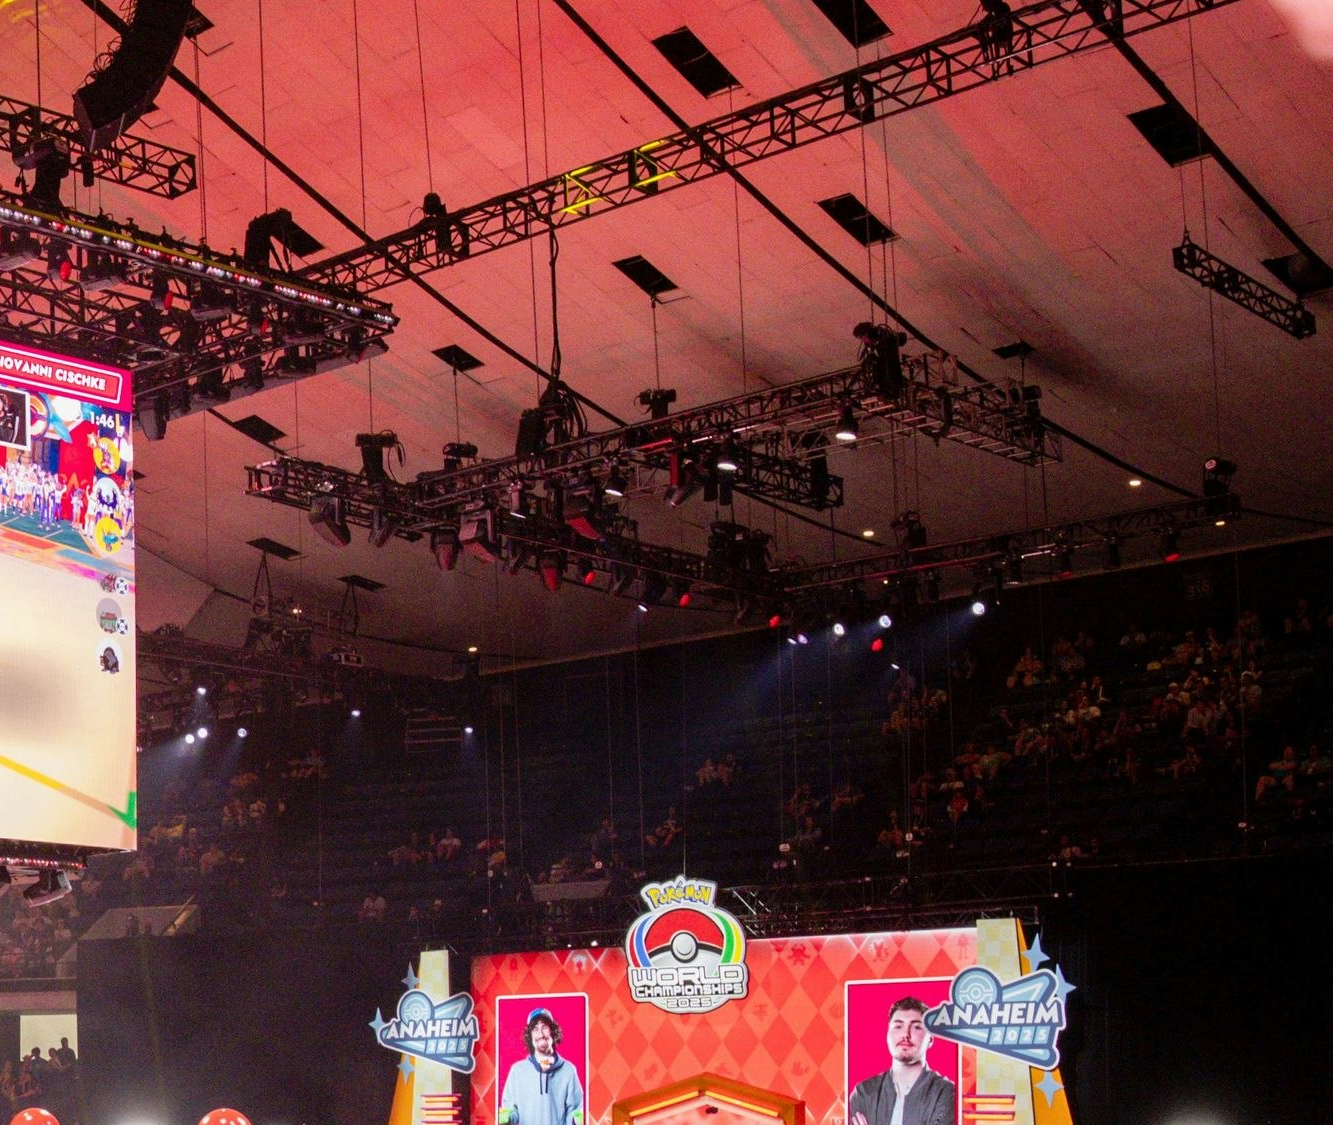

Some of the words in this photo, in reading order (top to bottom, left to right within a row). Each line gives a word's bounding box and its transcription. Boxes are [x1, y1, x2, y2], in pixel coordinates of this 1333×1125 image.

[55, 368, 106, 391] CISCHKE
[89, 410, 115, 429] 1:46
[631, 964, 745, 987] WORLD
[635, 983, 744, 998] CHAMPIONSHIPS
[666, 997, 712, 1009] 2025
[933, 999, 1060, 1027] ANAHEIM
[386, 1018, 475, 1039] ANAHEIM
[992, 1028, 1048, 1043] 2025
[427, 1040, 467, 1053] 2025
